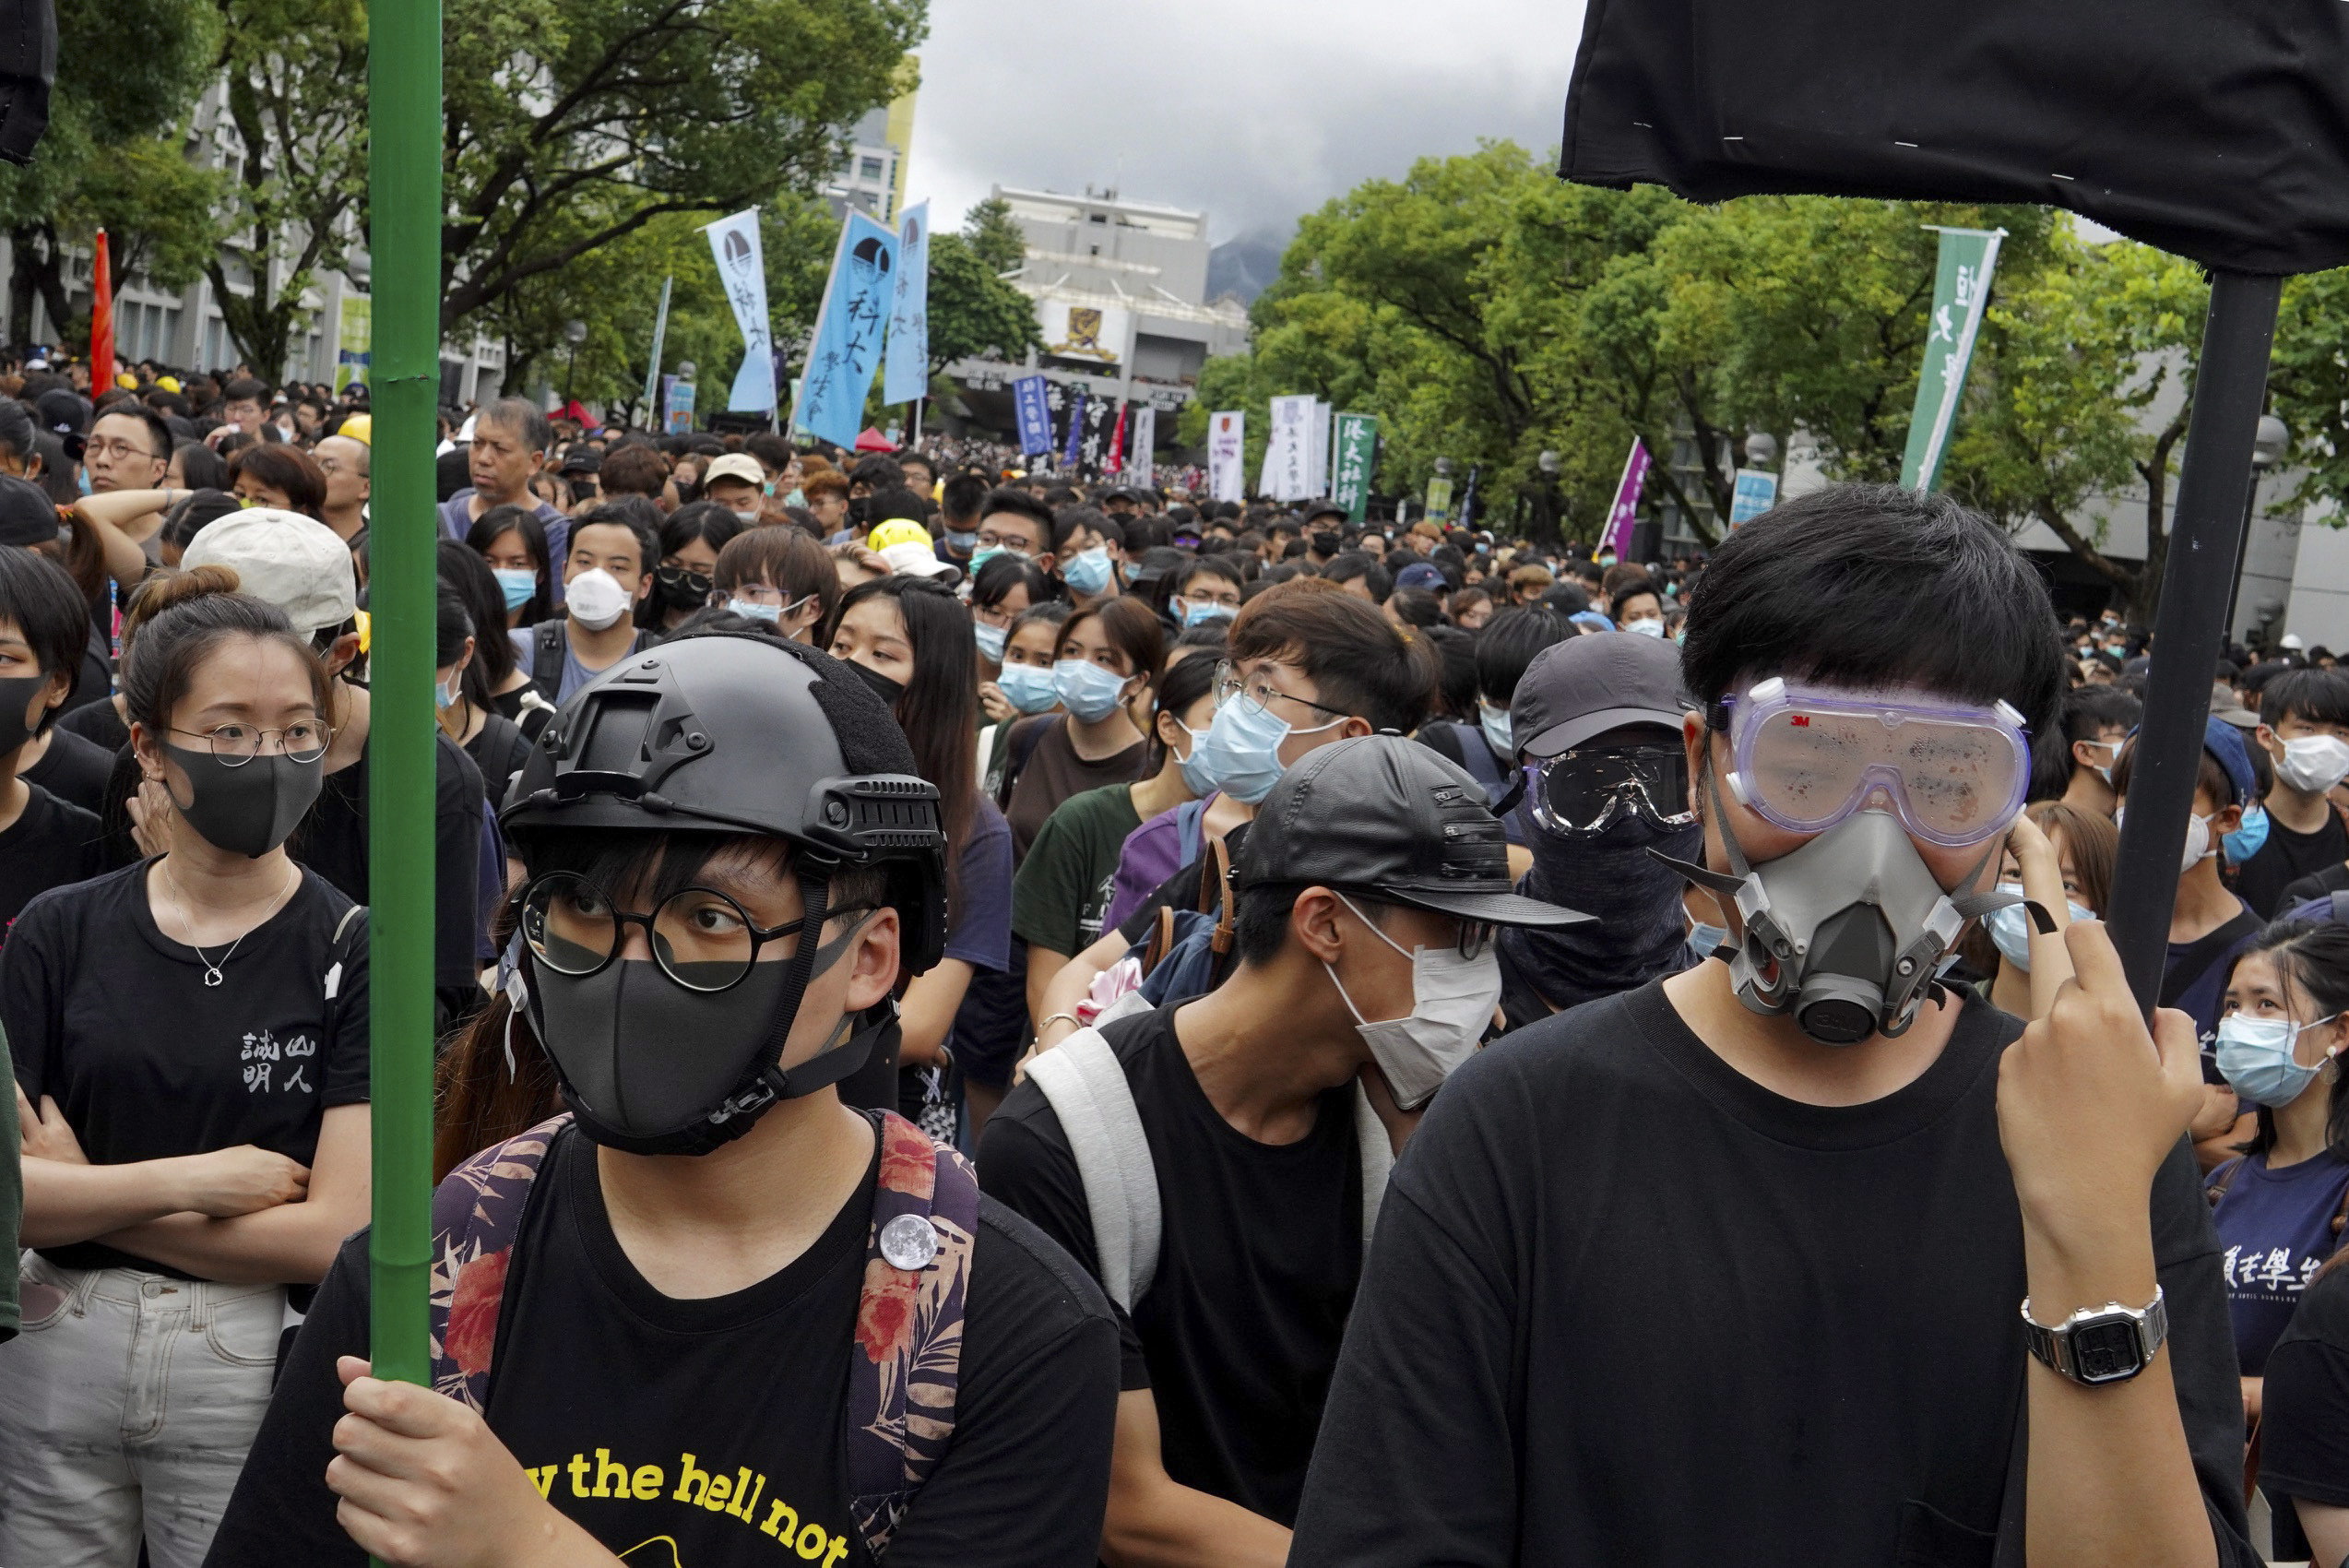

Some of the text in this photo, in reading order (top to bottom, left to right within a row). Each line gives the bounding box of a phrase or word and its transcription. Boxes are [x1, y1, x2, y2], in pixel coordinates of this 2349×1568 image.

[840, 288, 881, 374] 科大
[1791, 715, 1810, 728] 3M
[567, 1447, 665, 1502] the
[672, 1452, 766, 1525] hell
[759, 1498, 849, 1568] not
